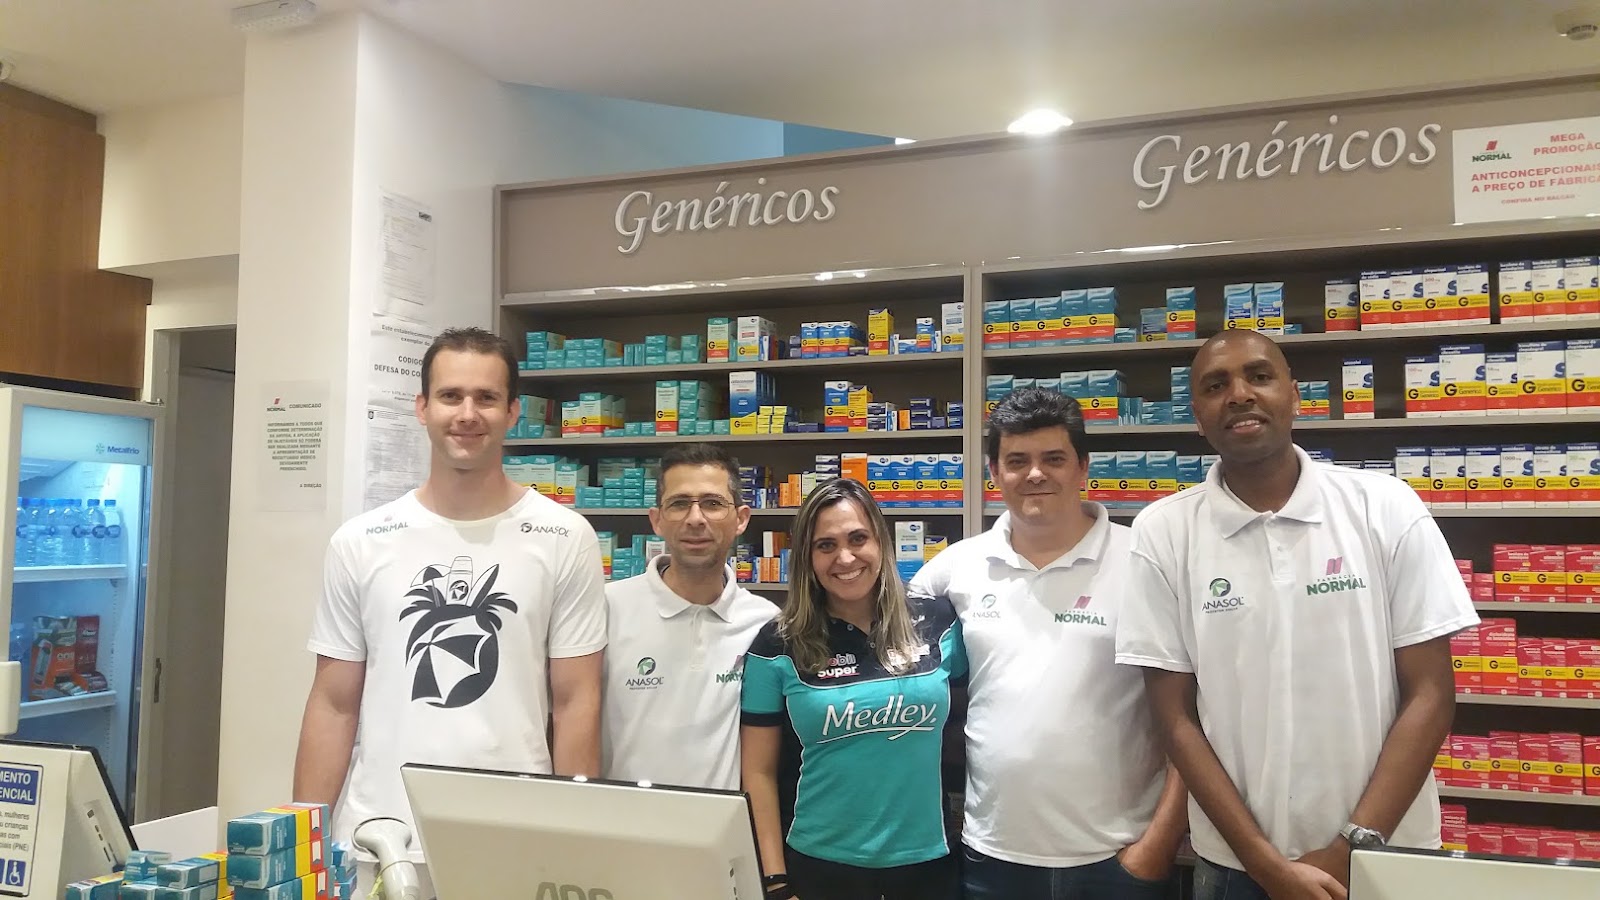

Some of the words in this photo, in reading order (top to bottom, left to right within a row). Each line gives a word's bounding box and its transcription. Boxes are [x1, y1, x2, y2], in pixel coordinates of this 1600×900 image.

[1550, 132, 1585, 142] MEGA
[1132, 115, 1441, 210] Genéricos
[1472, 153, 1512, 162] NORMAL
[1472, 185, 1480, 193] A
[1484, 181, 1525, 192] PREÇO
[1529, 179, 1545, 188] DE
[614, 177, 840, 254] Genéricos
[1502, 294, 1512, 305] G
[1534, 292, 1544, 303] G
[1567, 291, 1578, 301] G
[1362, 302, 1371, 312] G
[1392, 300, 1402, 311] G
[1425, 298, 1436, 309] G
[1458, 297, 1469, 307] G
[1328, 308, 1338, 319] G
[374, 364, 399, 374] DEFESA
[400, 368, 410, 376] DO
[1444, 383, 1457, 396] G
[1488, 386, 1498, 396] G
[1522, 381, 1536, 394] G
[1572, 379, 1585, 392] G
[1345, 390, 1354, 400] G
[1408, 388, 1419, 399] G
[1091, 398, 1100, 408] G
[1090, 480, 1099, 490] G
[1119, 480, 1128, 490] G
[1149, 480, 1158, 490] G
[1433, 478, 1444, 490] G
[1468, 478, 1478, 489] G
[1503, 478, 1513, 488] G
[1536, 478, 1546, 488] G
[1569, 477, 1580, 488] G
[366, 521, 409, 535] NORMAL
[532, 525, 569, 538] ANASOL
[1502, 573, 1511, 582] G
[1537, 573, 1547, 583] G
[1573, 574, 1584, 584] G
[1306, 577, 1367, 596] NORMAL
[1201, 597, 1244, 612] ANASOL
[1054, 613, 1107, 626] NORMAL
[828, 653, 857, 667] obil
[625, 677, 664, 687] ANASOL
[4, 811, 30, 821] mulheres
[4, 822, 29, 831] crianças
